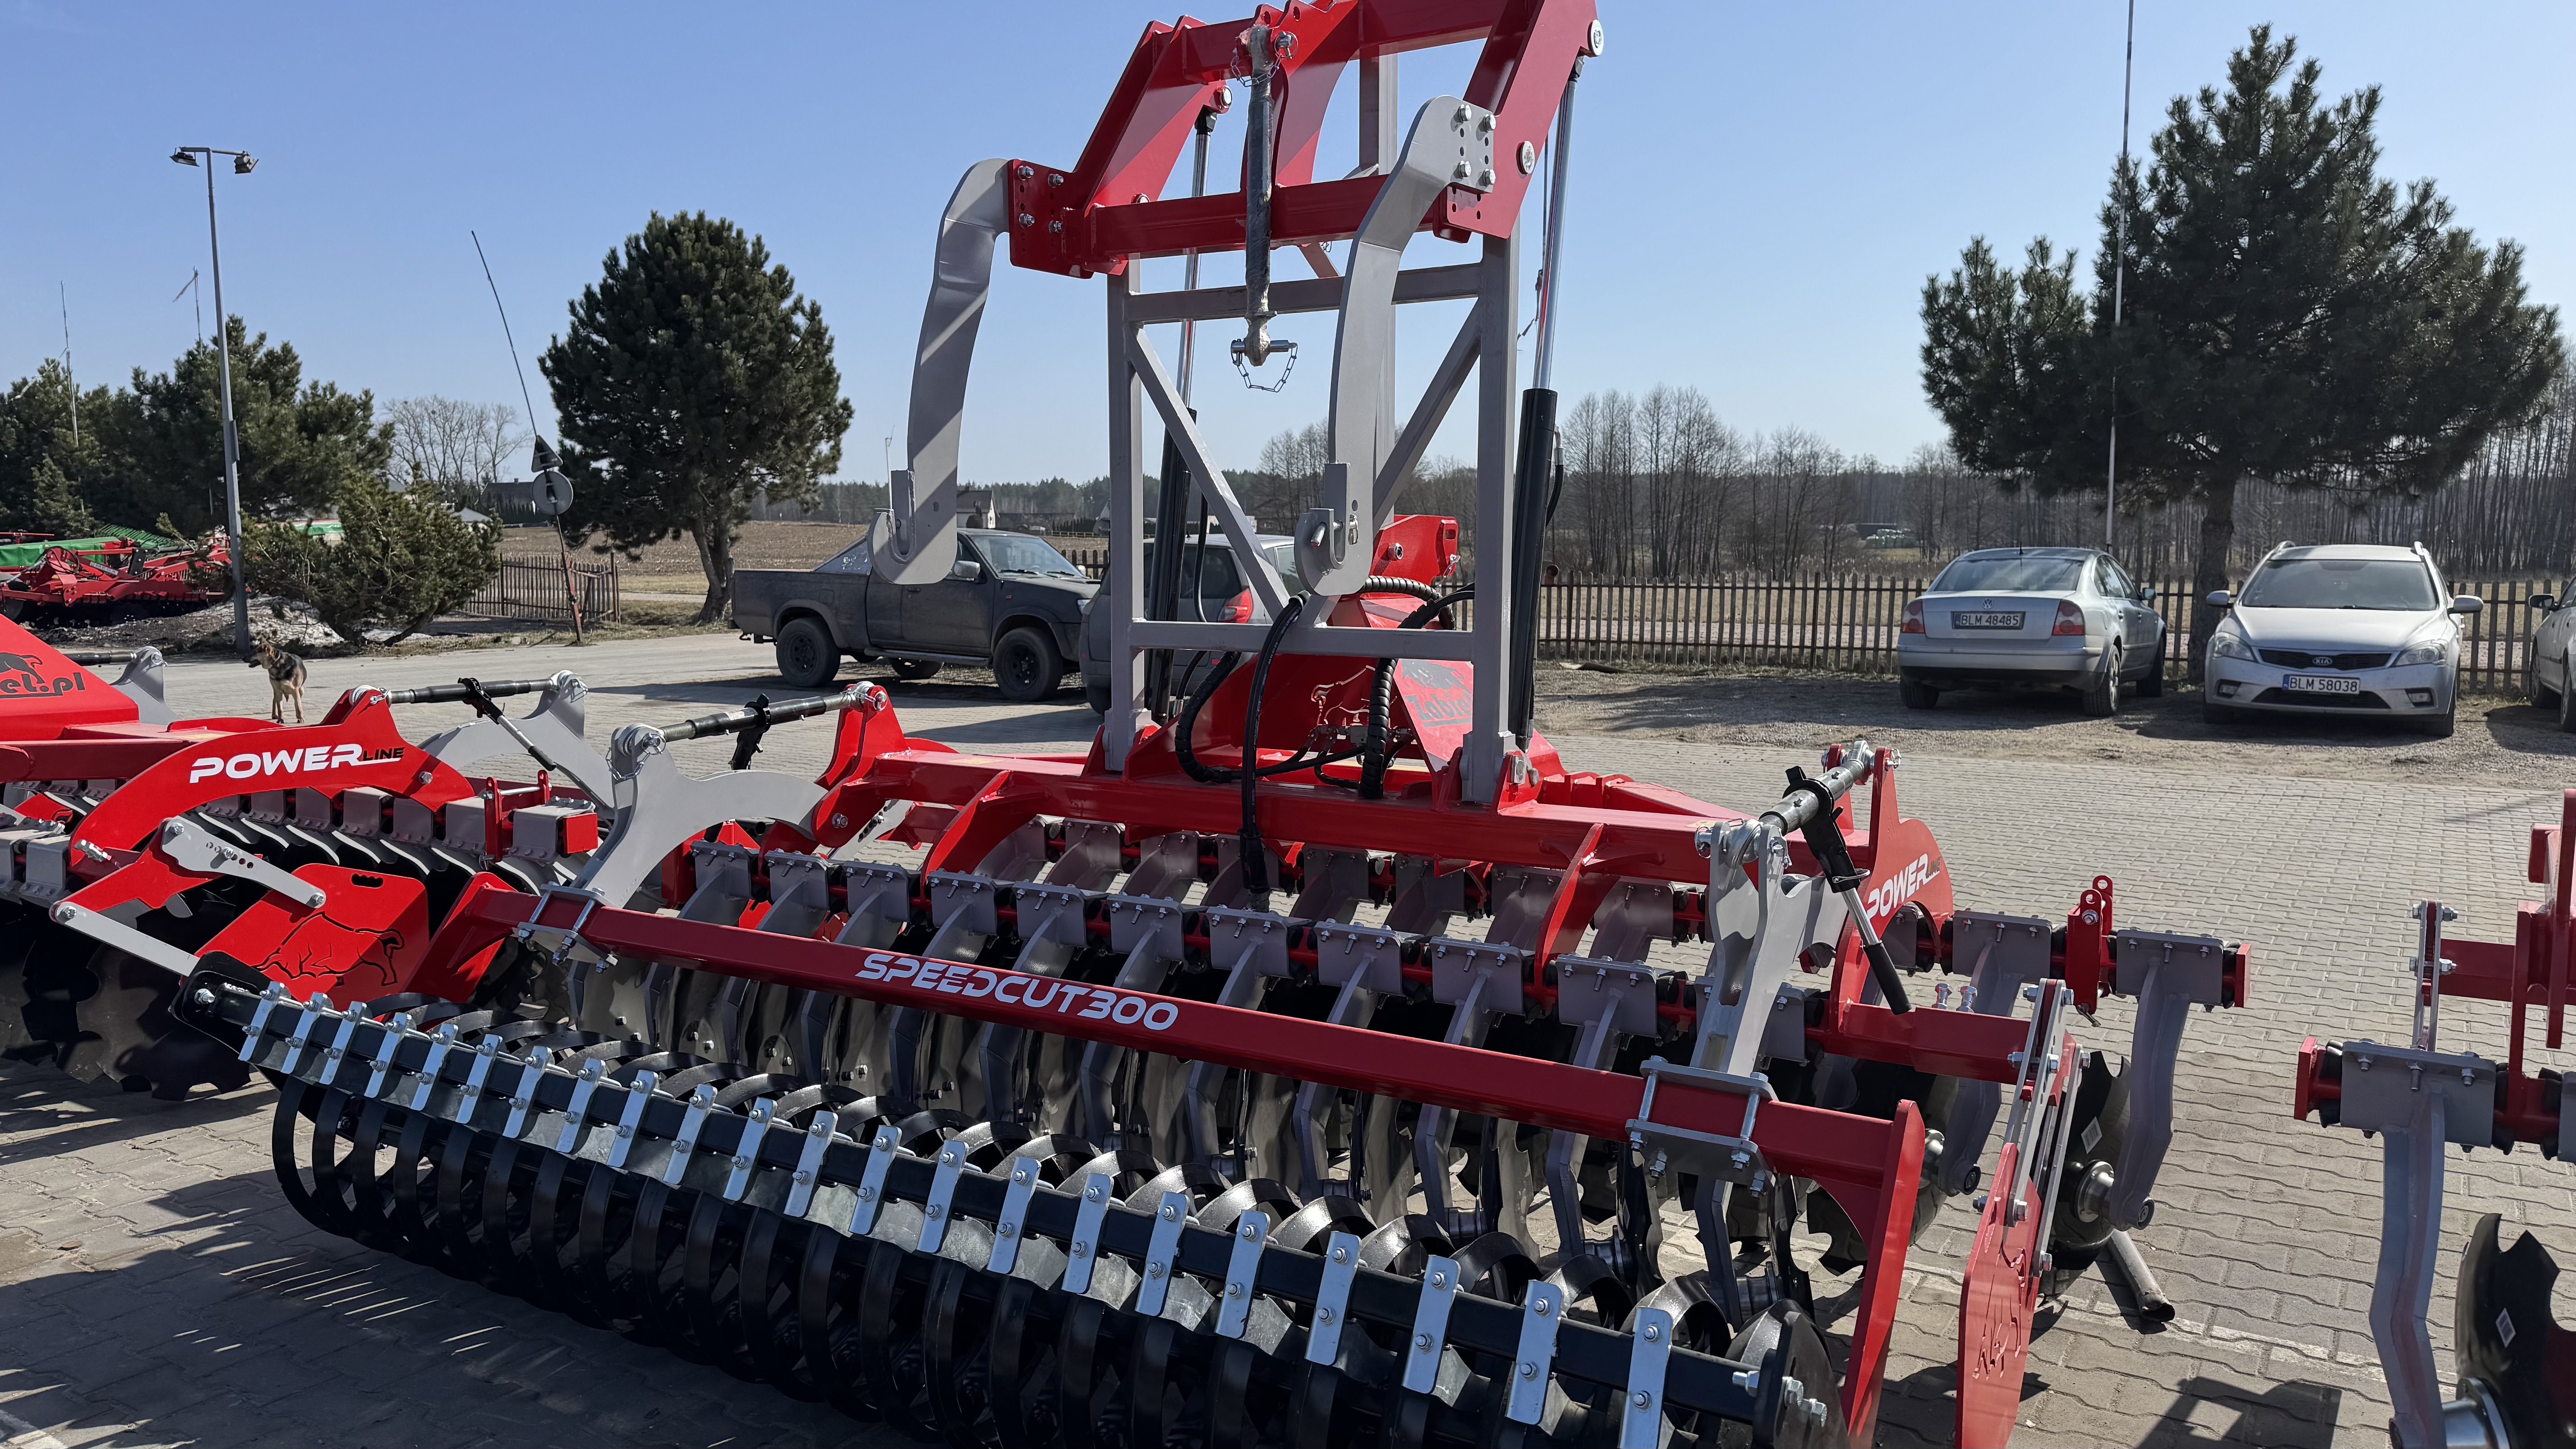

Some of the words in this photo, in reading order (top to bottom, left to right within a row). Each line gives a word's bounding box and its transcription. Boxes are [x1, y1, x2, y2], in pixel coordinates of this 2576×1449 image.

[1961, 615, 1982, 626] BLM
[1985, 615, 2019, 626] 48485
[2290, 677, 2314, 690] BLM
[2318, 679, 2358, 692] 58038
[189, 743, 363, 784] POWER
[363, 746, 405, 762] LINE
[1867, 853, 1928, 919] POWER
